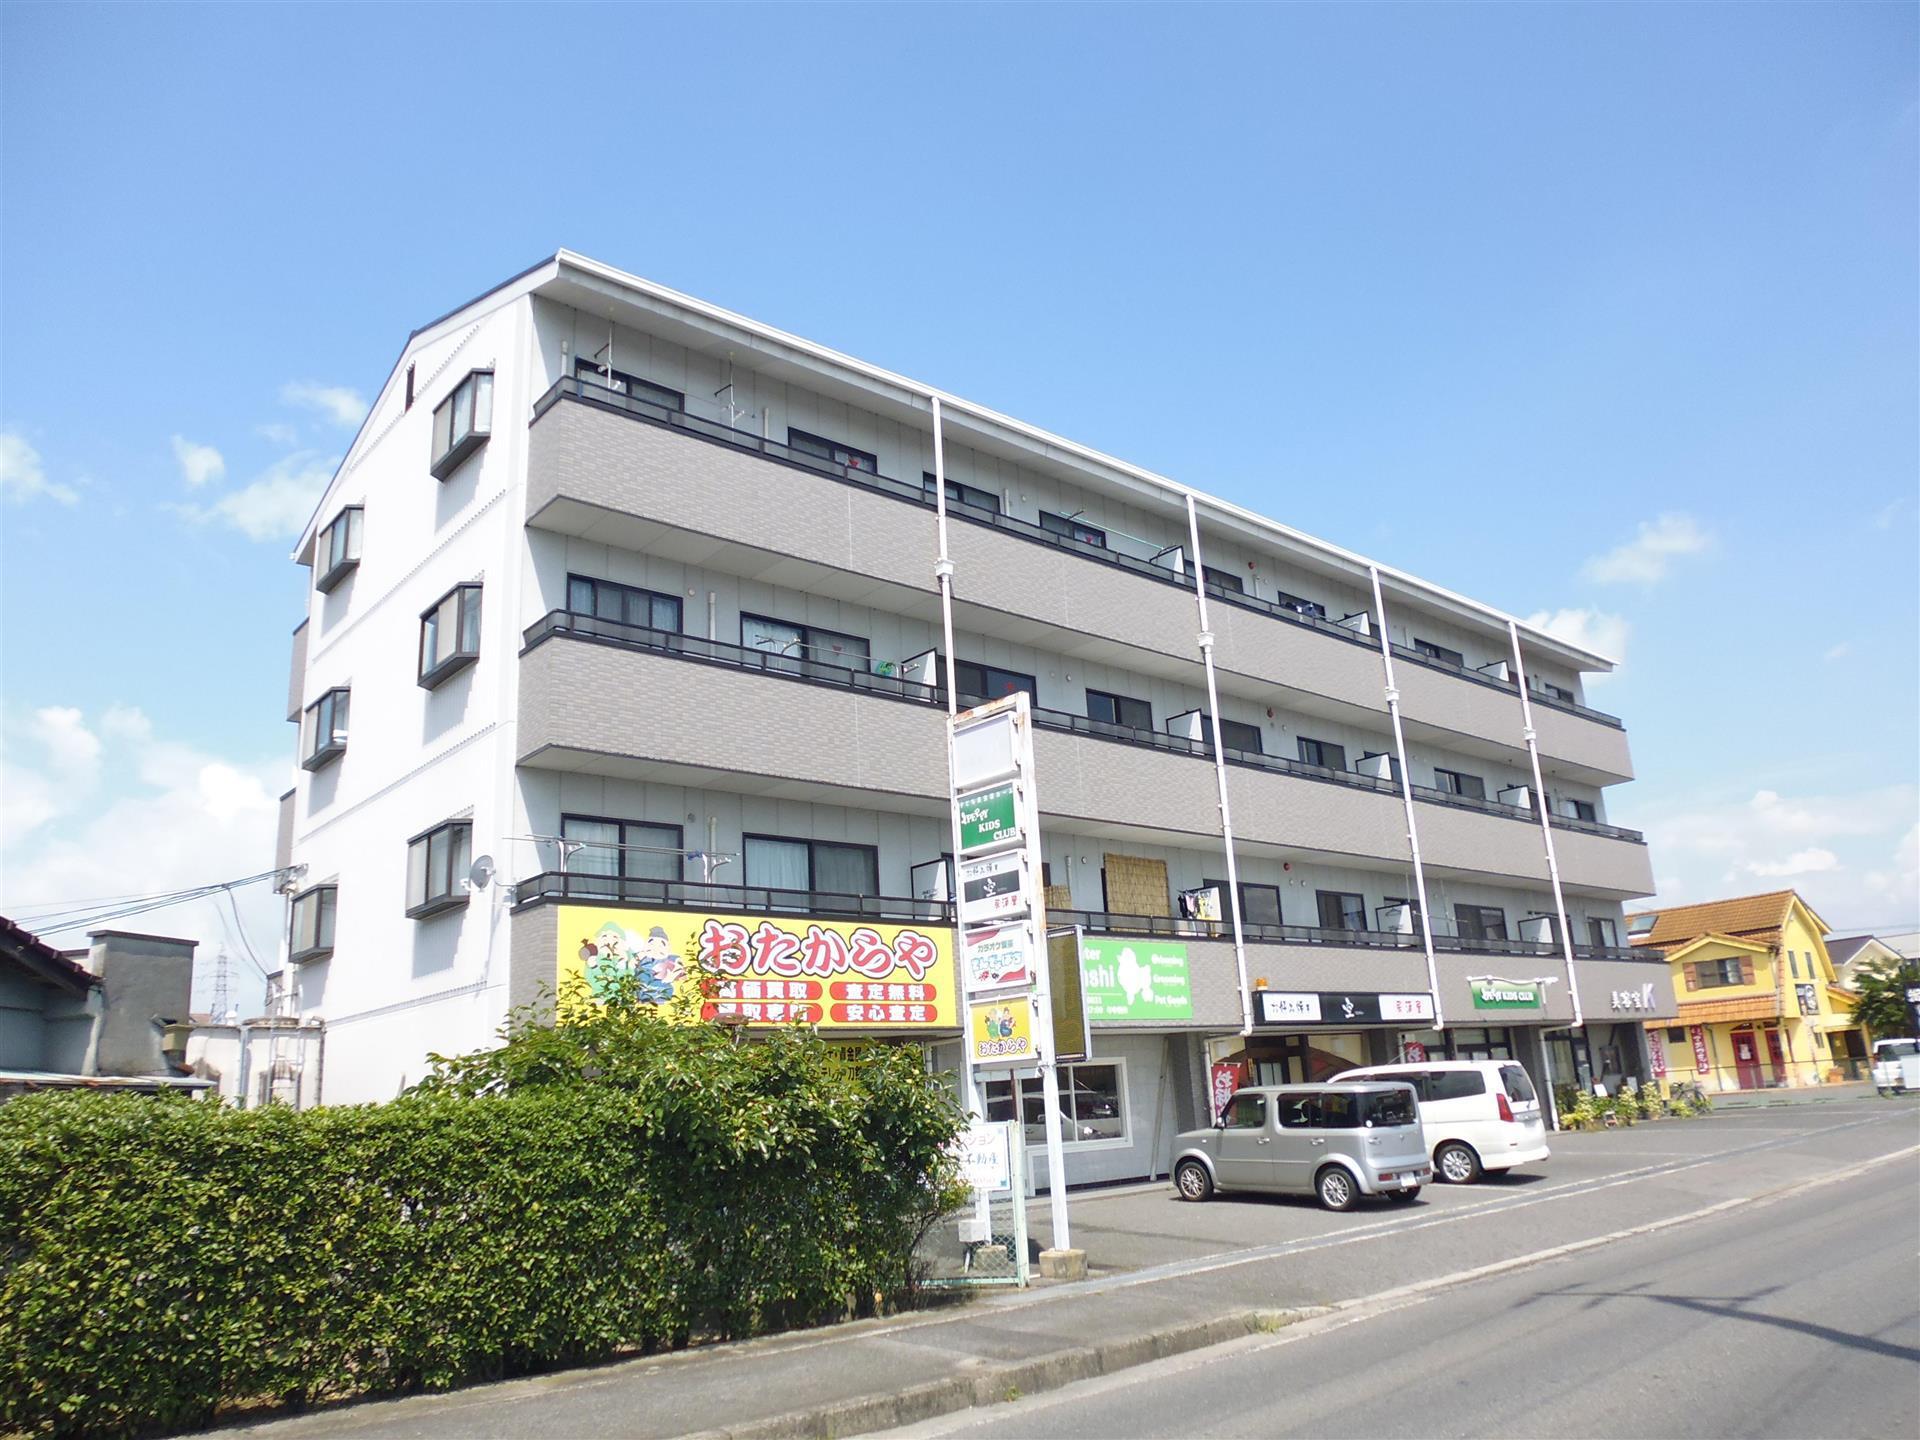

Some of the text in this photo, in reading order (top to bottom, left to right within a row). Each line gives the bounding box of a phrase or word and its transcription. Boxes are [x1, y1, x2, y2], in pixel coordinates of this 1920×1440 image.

[966, 808, 990, 823] PEPPY
[978, 819, 1001, 833] KIDS
[993, 827, 1016, 841] CLUB
[698, 919, 938, 982] おたからや
[846, 983, 925, 1000] 査定無料
[1642, 983, 1656, 1008] K
[847, 1004, 926, 1021] 安心査定
[978, 1037, 1028, 1057] おたからや
